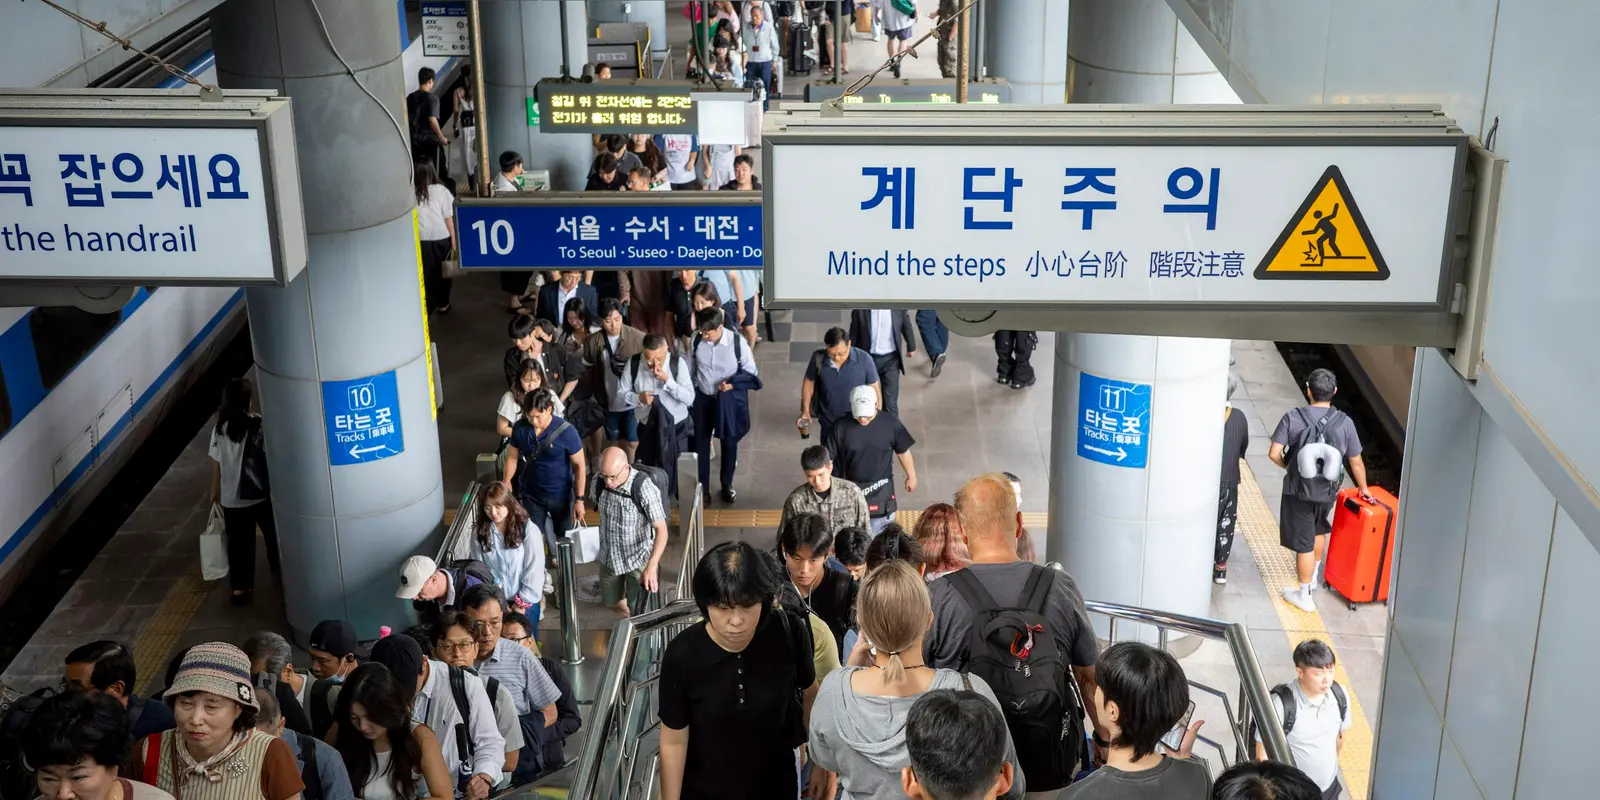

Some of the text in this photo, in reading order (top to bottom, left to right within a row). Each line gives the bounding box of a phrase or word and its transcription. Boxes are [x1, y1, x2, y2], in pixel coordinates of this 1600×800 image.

[552, 112, 587, 124] 전기가
[59, 153, 249, 207] 잡으세요
[1, 224, 197, 252] the handrail
[471, 219, 515, 255] 10
[556, 215, 739, 241] 서울 수서 대전
[558, 246, 576, 259] To
[579, 246, 616, 259] Seoul
[628, 246, 668, 259] Suseo
[678, 246, 733, 261] Daejeon
[1024, 251, 1128, 278] 小心台阶
[1149, 250, 1246, 278] 階段注意
[828, 250, 1006, 282] Mind the steps
[351, 386, 371, 407] 10
[1104, 388, 1120, 409] 11
[335, 407, 391, 430] 타는 곳
[1085, 408, 1141, 433] 타는 곳
[335, 431, 366, 443] Tracks
[1083, 427, 1109, 442] Tracks
[862, 478, 889, 496] preme
